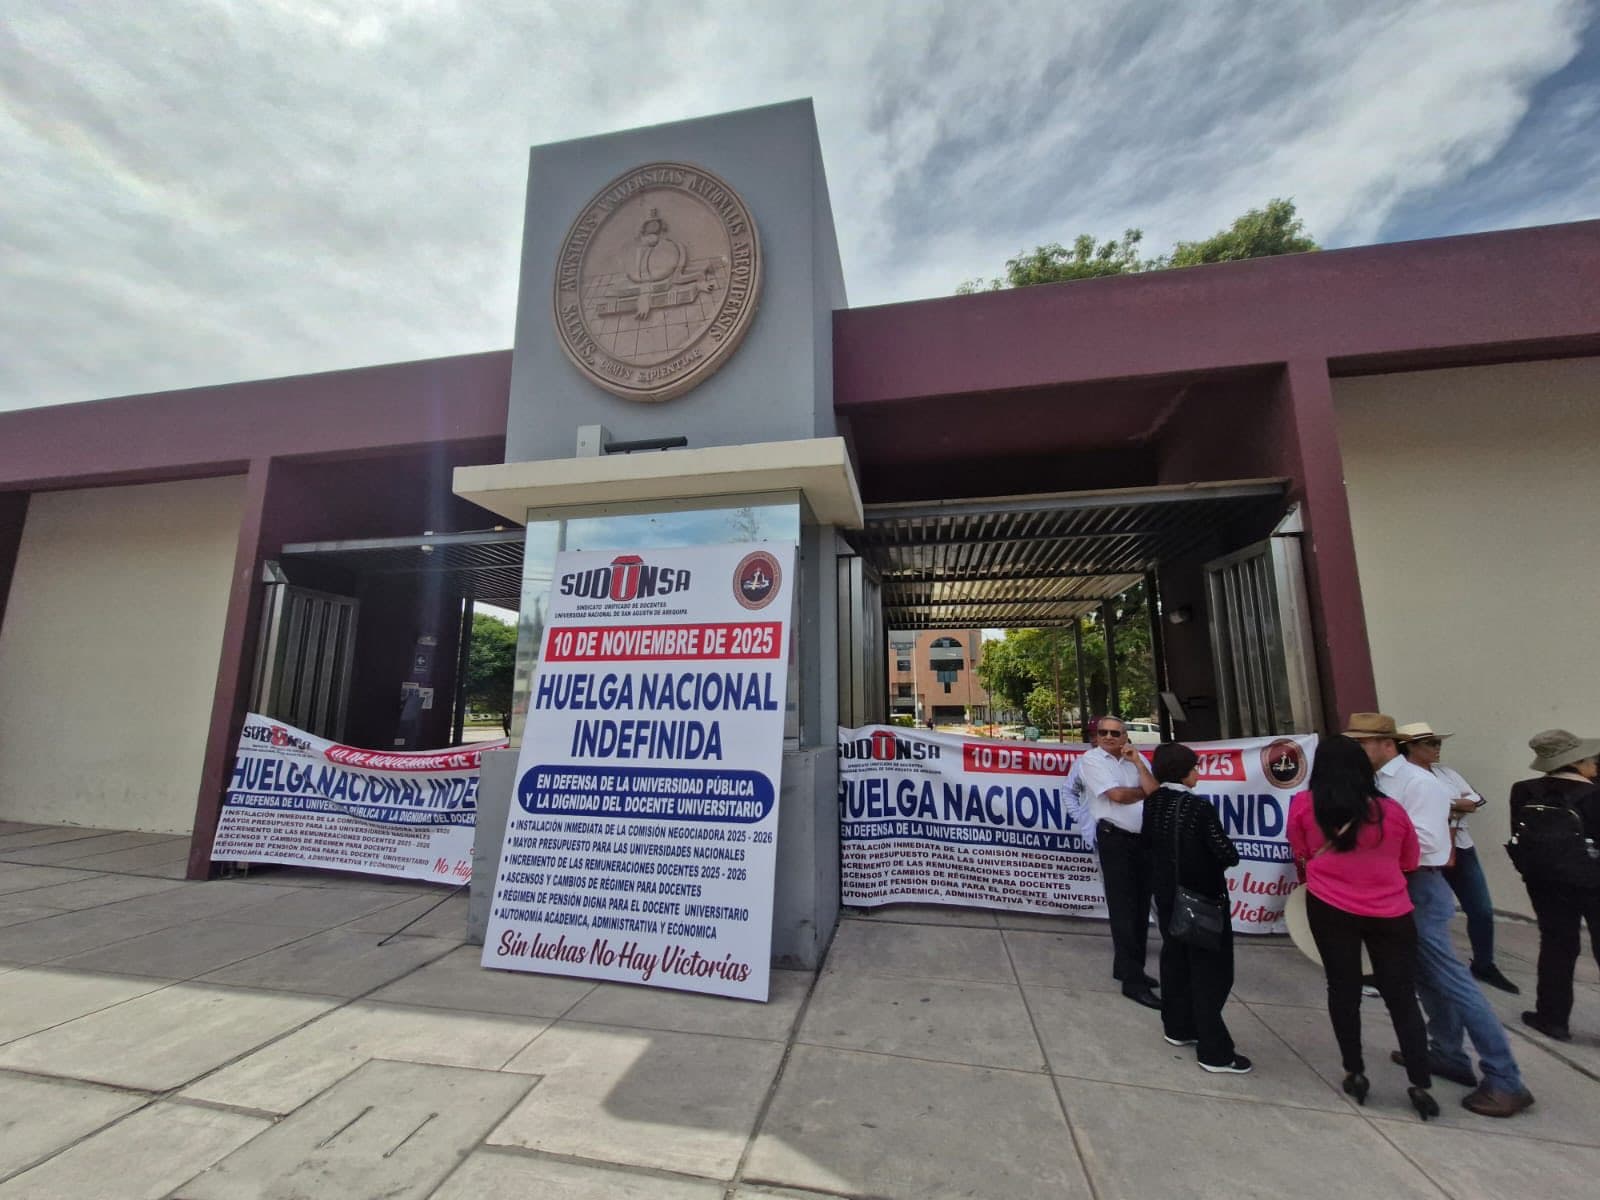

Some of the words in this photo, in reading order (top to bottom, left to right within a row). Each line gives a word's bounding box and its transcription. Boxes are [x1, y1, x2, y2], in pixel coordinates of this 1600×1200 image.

[559, 554, 691, 602] SUDUNSA
[554, 632, 572, 656] 10
[575, 631, 598, 656] DE
[600, 629, 699, 655] NOVIEMBRE
[703, 628, 727, 654] DE
[730, 627, 773, 653] 2025
[535, 673, 633, 710] HUELGA
[638, 672, 778, 710] NACIONAL
[571, 719, 722, 760] INDEFINIDA
[971, 747, 991, 769] 10
[998, 749, 1024, 770] DE
[1198, 754, 1233, 776] 025
[317, 765, 426, 806] NACIONAL
[536, 774, 551, 788] EN
[552, 774, 597, 790] DEFENSA
[600, 775, 614, 791] DE
[616, 776, 629, 791] LA
[632, 777, 703, 794] UNIVERSIDAD
[706, 775, 754, 796] PÚBLICA
[245, 795, 280, 806] DEFENSA
[282, 797, 293, 807] DE
[294, 798, 304, 808] LA
[526, 793, 533, 807] Y
[536, 793, 549, 808] LA
[551, 794, 600, 810] DIGNIDAD
[602, 795, 621, 811] DEL
[624, 796, 675, 814] DOCENTE
[677, 799, 764, 818] UNIVERSITARIO
[943, 782, 1079, 831] NACION
[563, 822, 602, 834] INMEDIATA
[604, 824, 615, 835] DE
[616, 824, 626, 835] LA
[667, 827, 724, 840] NEGOCIADORA
[727, 830, 746, 842] 2025
[753, 831, 772, 843] 2026
[853, 823, 894, 836] DEFENSA
[896, 823, 908, 835] DE
[911, 824, 923, 836] LA
[926, 825, 992, 841] UNIVERSIDAD
[1043, 835, 1051, 847] Y
[1056, 837, 1070, 848] LA
[513, 836, 537, 848] MAYOR
[538, 838, 590, 851] PRESUPUESTO
[592, 840, 611, 853] PARA
[613, 842, 628, 854] LAS
[629, 843, 691, 858] UNIVERSIDADES
[693, 846, 744, 861] NACIONALES
[433, 857, 449, 873] No
[509, 854, 556, 867] INCREMENTO
[557, 856, 567, 868] DE
[568, 858, 583, 869] LAS
[584, 858, 655, 874] REMUNERACIONES
[656, 863, 699, 877] DOCENTES
[700, 866, 720, 879] 2025
[727, 867, 746, 880] 2026
[505, 872, 544, 885] ASCENSOS
[546, 874, 551, 885] Y
[552, 874, 586, 888] CAMBIOS
[587, 877, 598, 889] DE
[636, 880, 656, 893] PARA
[658, 882, 701, 897] DOCENTES
[536, 892, 547, 904] DE
[582, 895, 606, 909] DIGNA
[608, 897, 628, 910] PARA
[630, 899, 640, 912] EL
[642, 900, 680, 915] DOCENTE
[684, 904, 748, 921] UNIVERSITARIO
[530, 932, 586, 963] luchas
[589, 938, 614, 966] No
[618, 941, 656, 981] Hay
